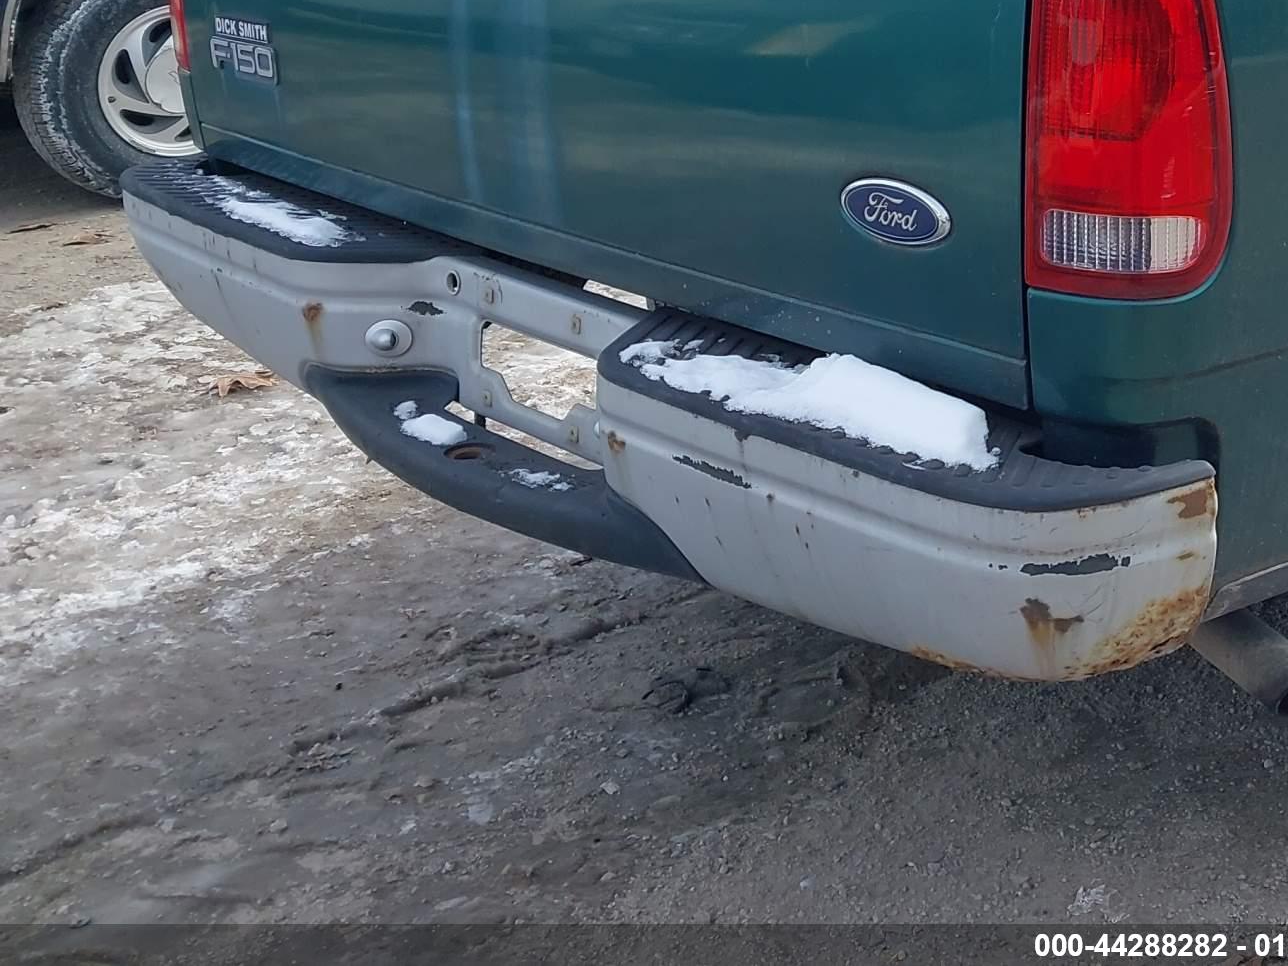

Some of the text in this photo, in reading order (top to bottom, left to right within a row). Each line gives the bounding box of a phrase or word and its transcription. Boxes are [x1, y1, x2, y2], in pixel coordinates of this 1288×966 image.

[215, 17, 268, 41] DICK SMITH
[210, 38, 273, 78] F-150
[864, 192, 918, 231] Ford
